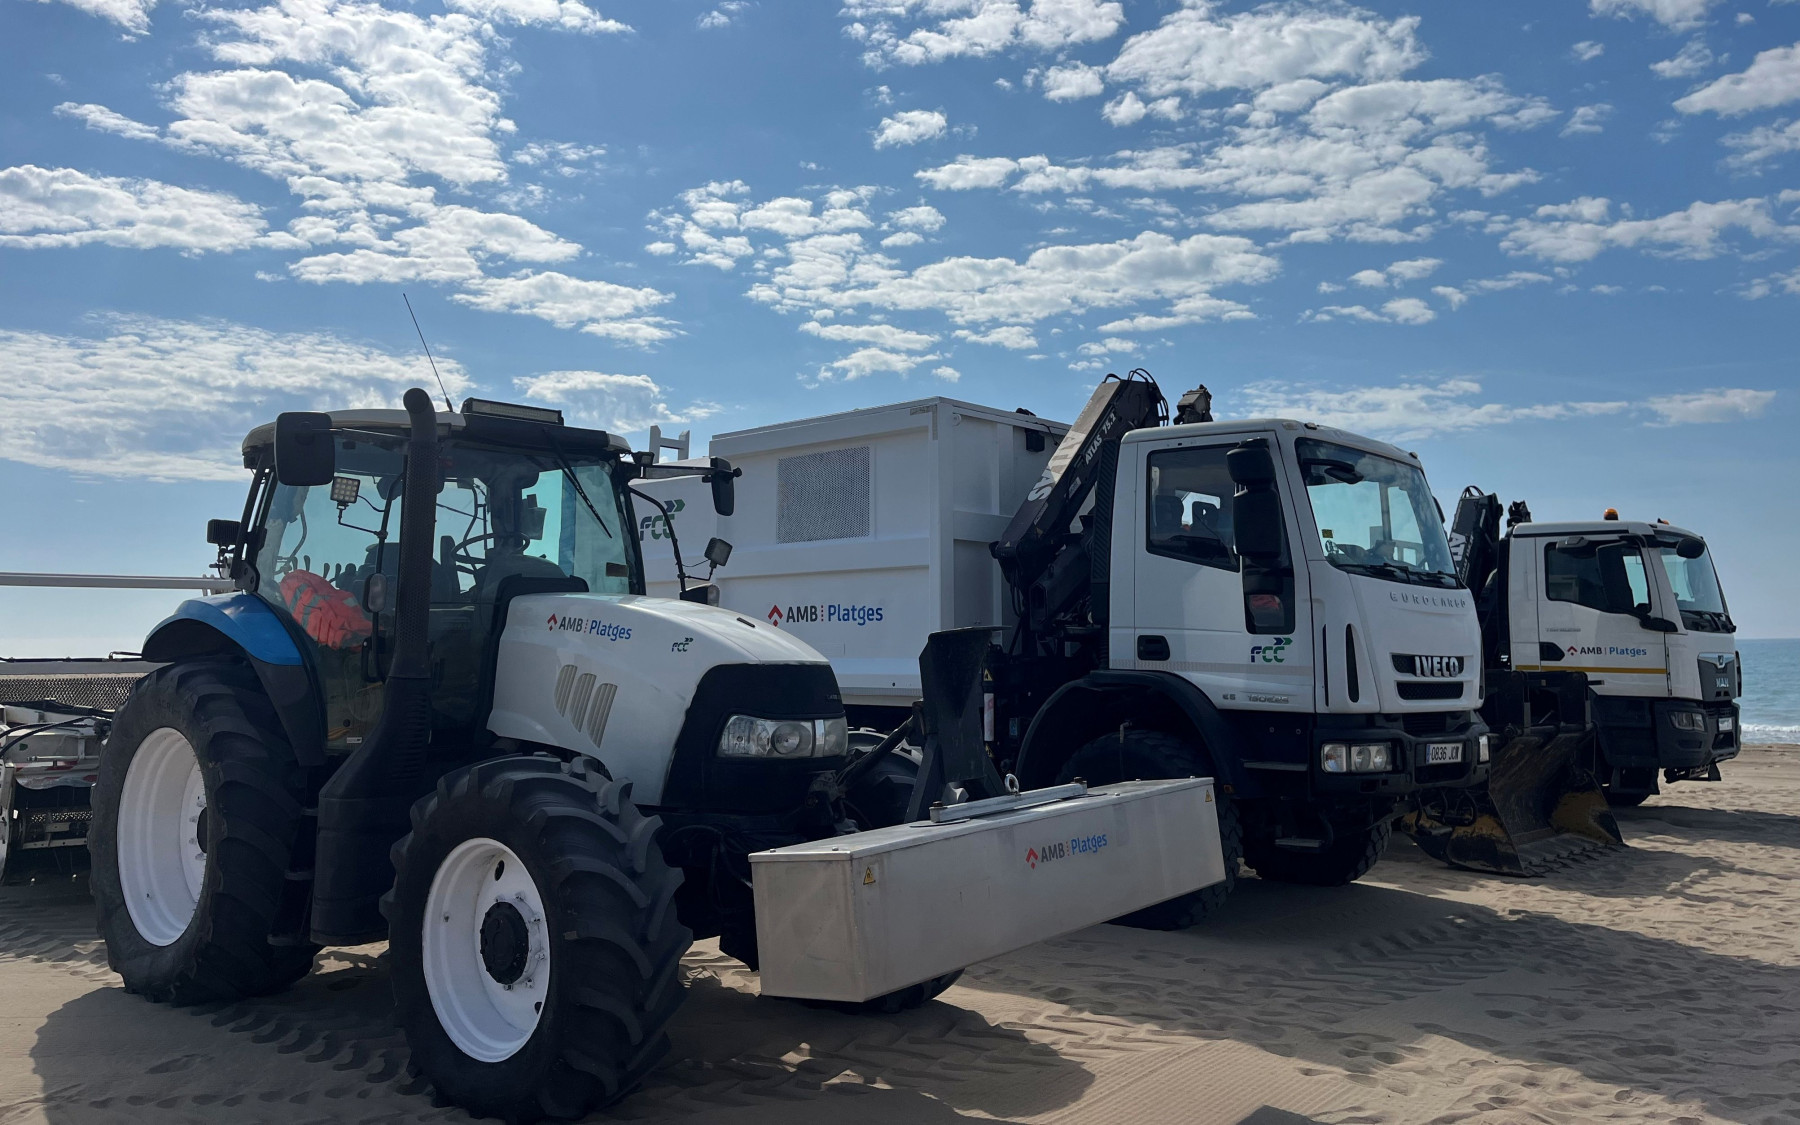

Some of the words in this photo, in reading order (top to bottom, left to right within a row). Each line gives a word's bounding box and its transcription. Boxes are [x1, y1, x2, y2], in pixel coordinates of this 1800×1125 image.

[1085, 435, 1103, 465] ATLAS
[1102, 412, 1117, 435] 75.2
[786, 605, 818, 623] AMB
[828, 604, 883, 626] Platges
[558, 616, 584, 633] AMB
[589, 619, 633, 642] Platges
[1250, 646, 1285, 663] FCC
[1580, 646, 1602, 655] AMB
[1609, 646, 1647, 657] Platges
[1414, 655, 1459, 677] IVECO
[1041, 842, 1065, 863] AMB
[1070, 834, 1108, 855] Platges
